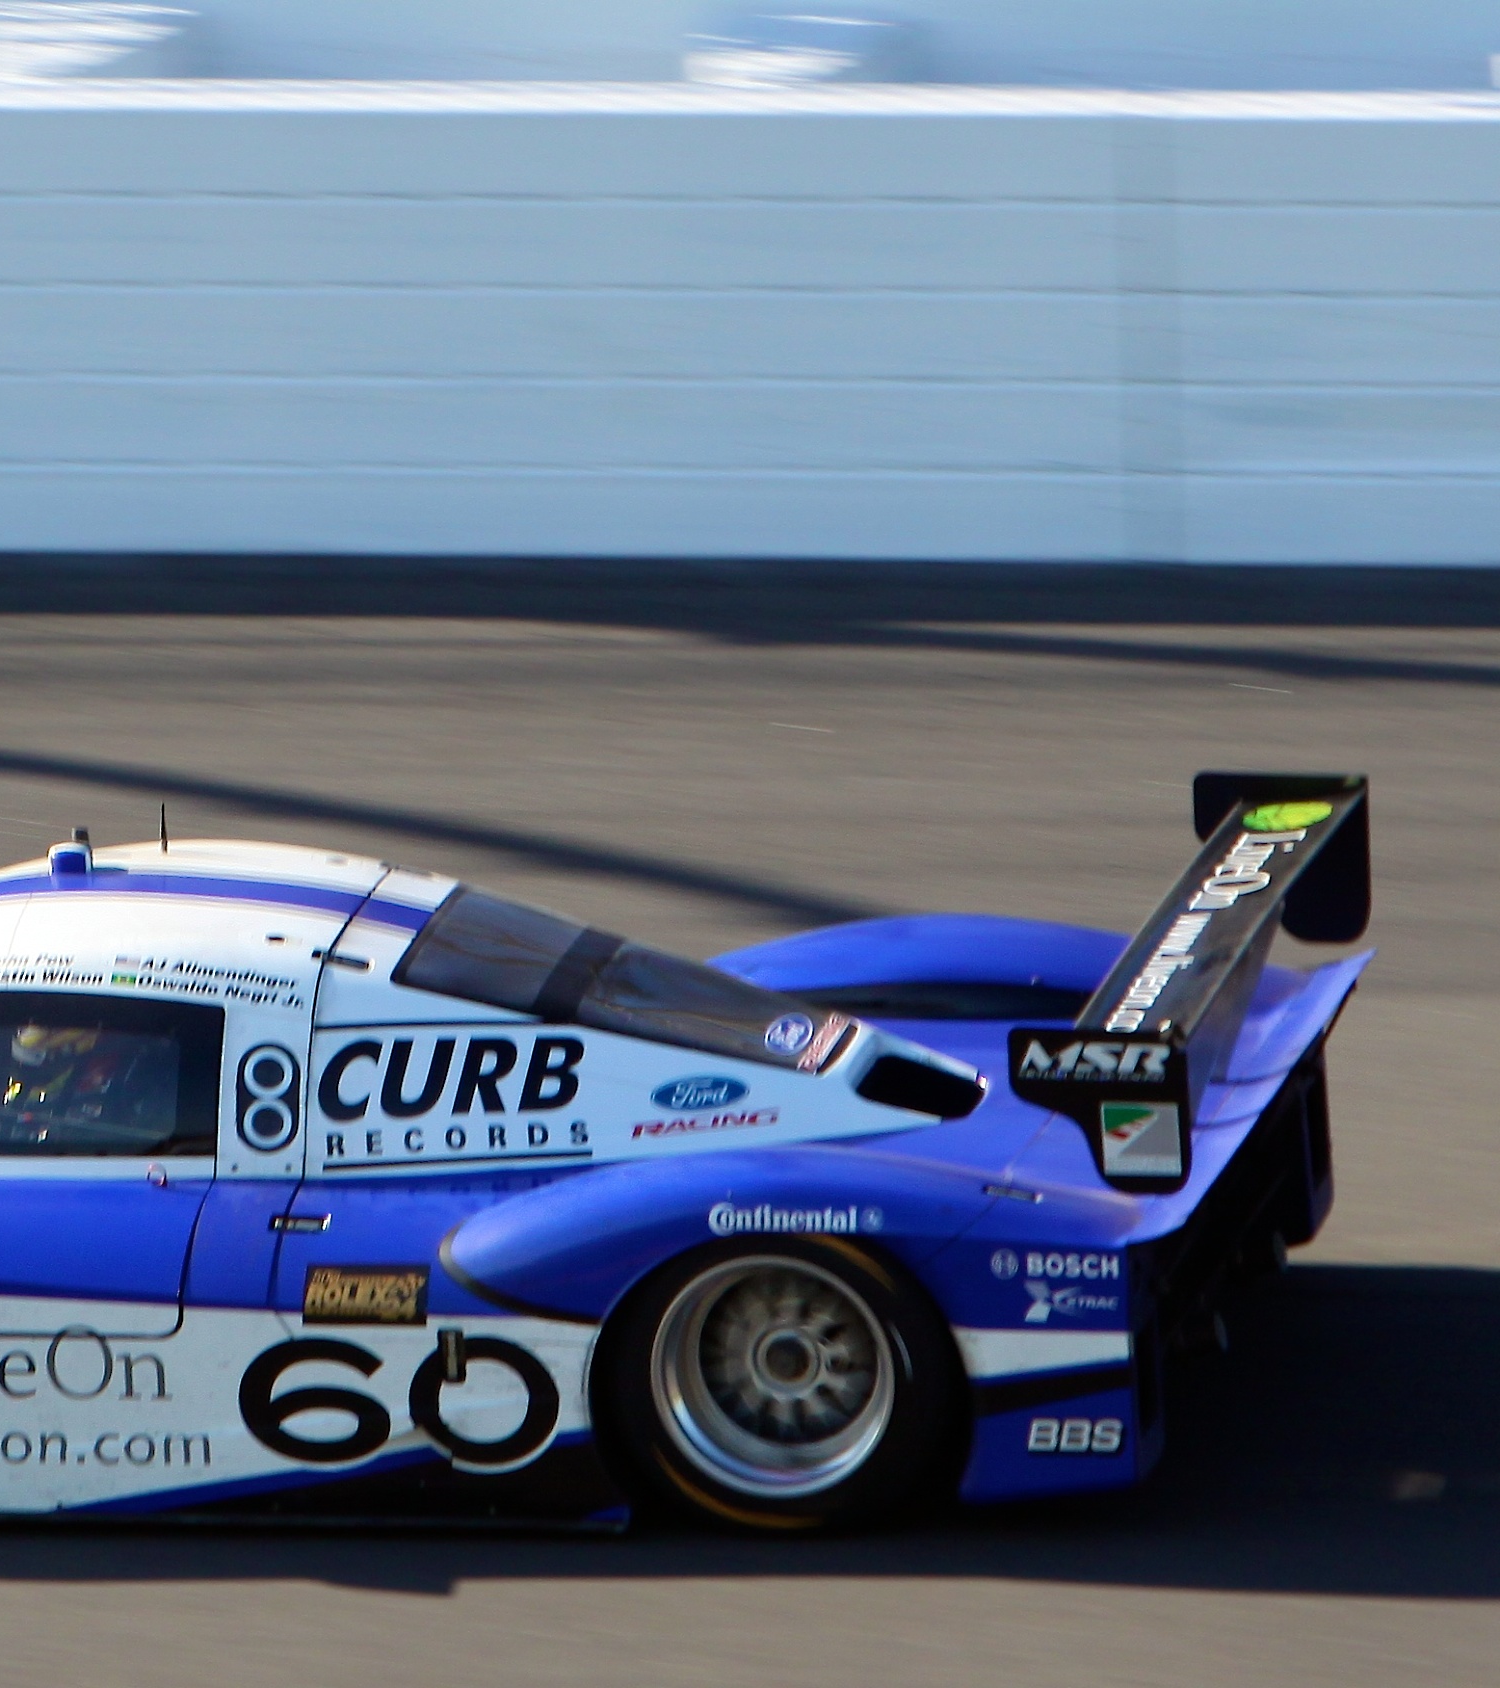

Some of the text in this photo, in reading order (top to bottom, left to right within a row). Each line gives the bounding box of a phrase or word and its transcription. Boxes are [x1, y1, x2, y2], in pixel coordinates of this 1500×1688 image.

[1018, 1039, 1171, 1077] MSR
[317, 1036, 585, 1123] CURB
[325, 1120, 590, 1159] RECORDS
[631, 1107, 781, 1141] RACING
[708, 1202, 857, 1237] Continental
[1026, 1252, 1120, 1281] BOSCH
[238, 1336, 560, 1466] 60
[1027, 1418, 1124, 1453] BBS
